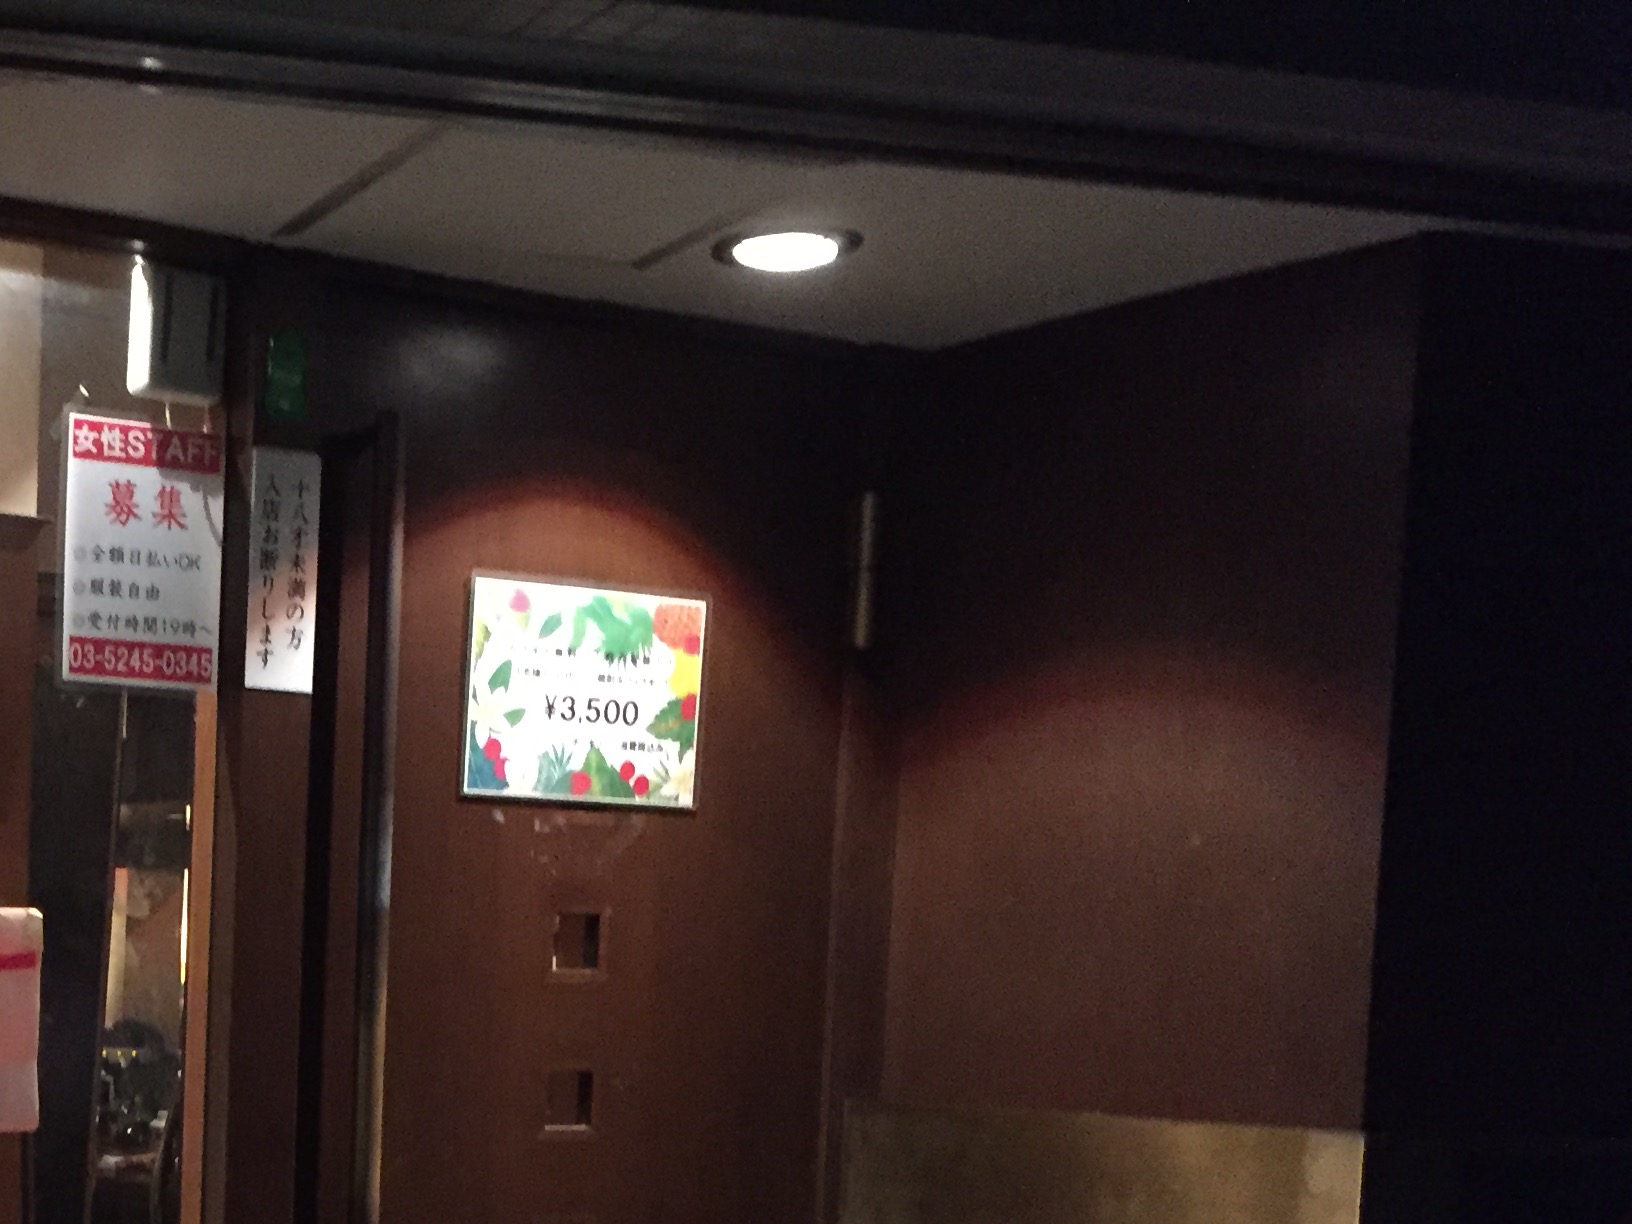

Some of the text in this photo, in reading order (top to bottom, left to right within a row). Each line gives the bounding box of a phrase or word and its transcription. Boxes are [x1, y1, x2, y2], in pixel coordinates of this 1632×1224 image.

[105, 480, 188, 531] 募集
[69, 644, 213, 681] 03-5245-0345
[544, 695, 639, 726] ¥3,500
